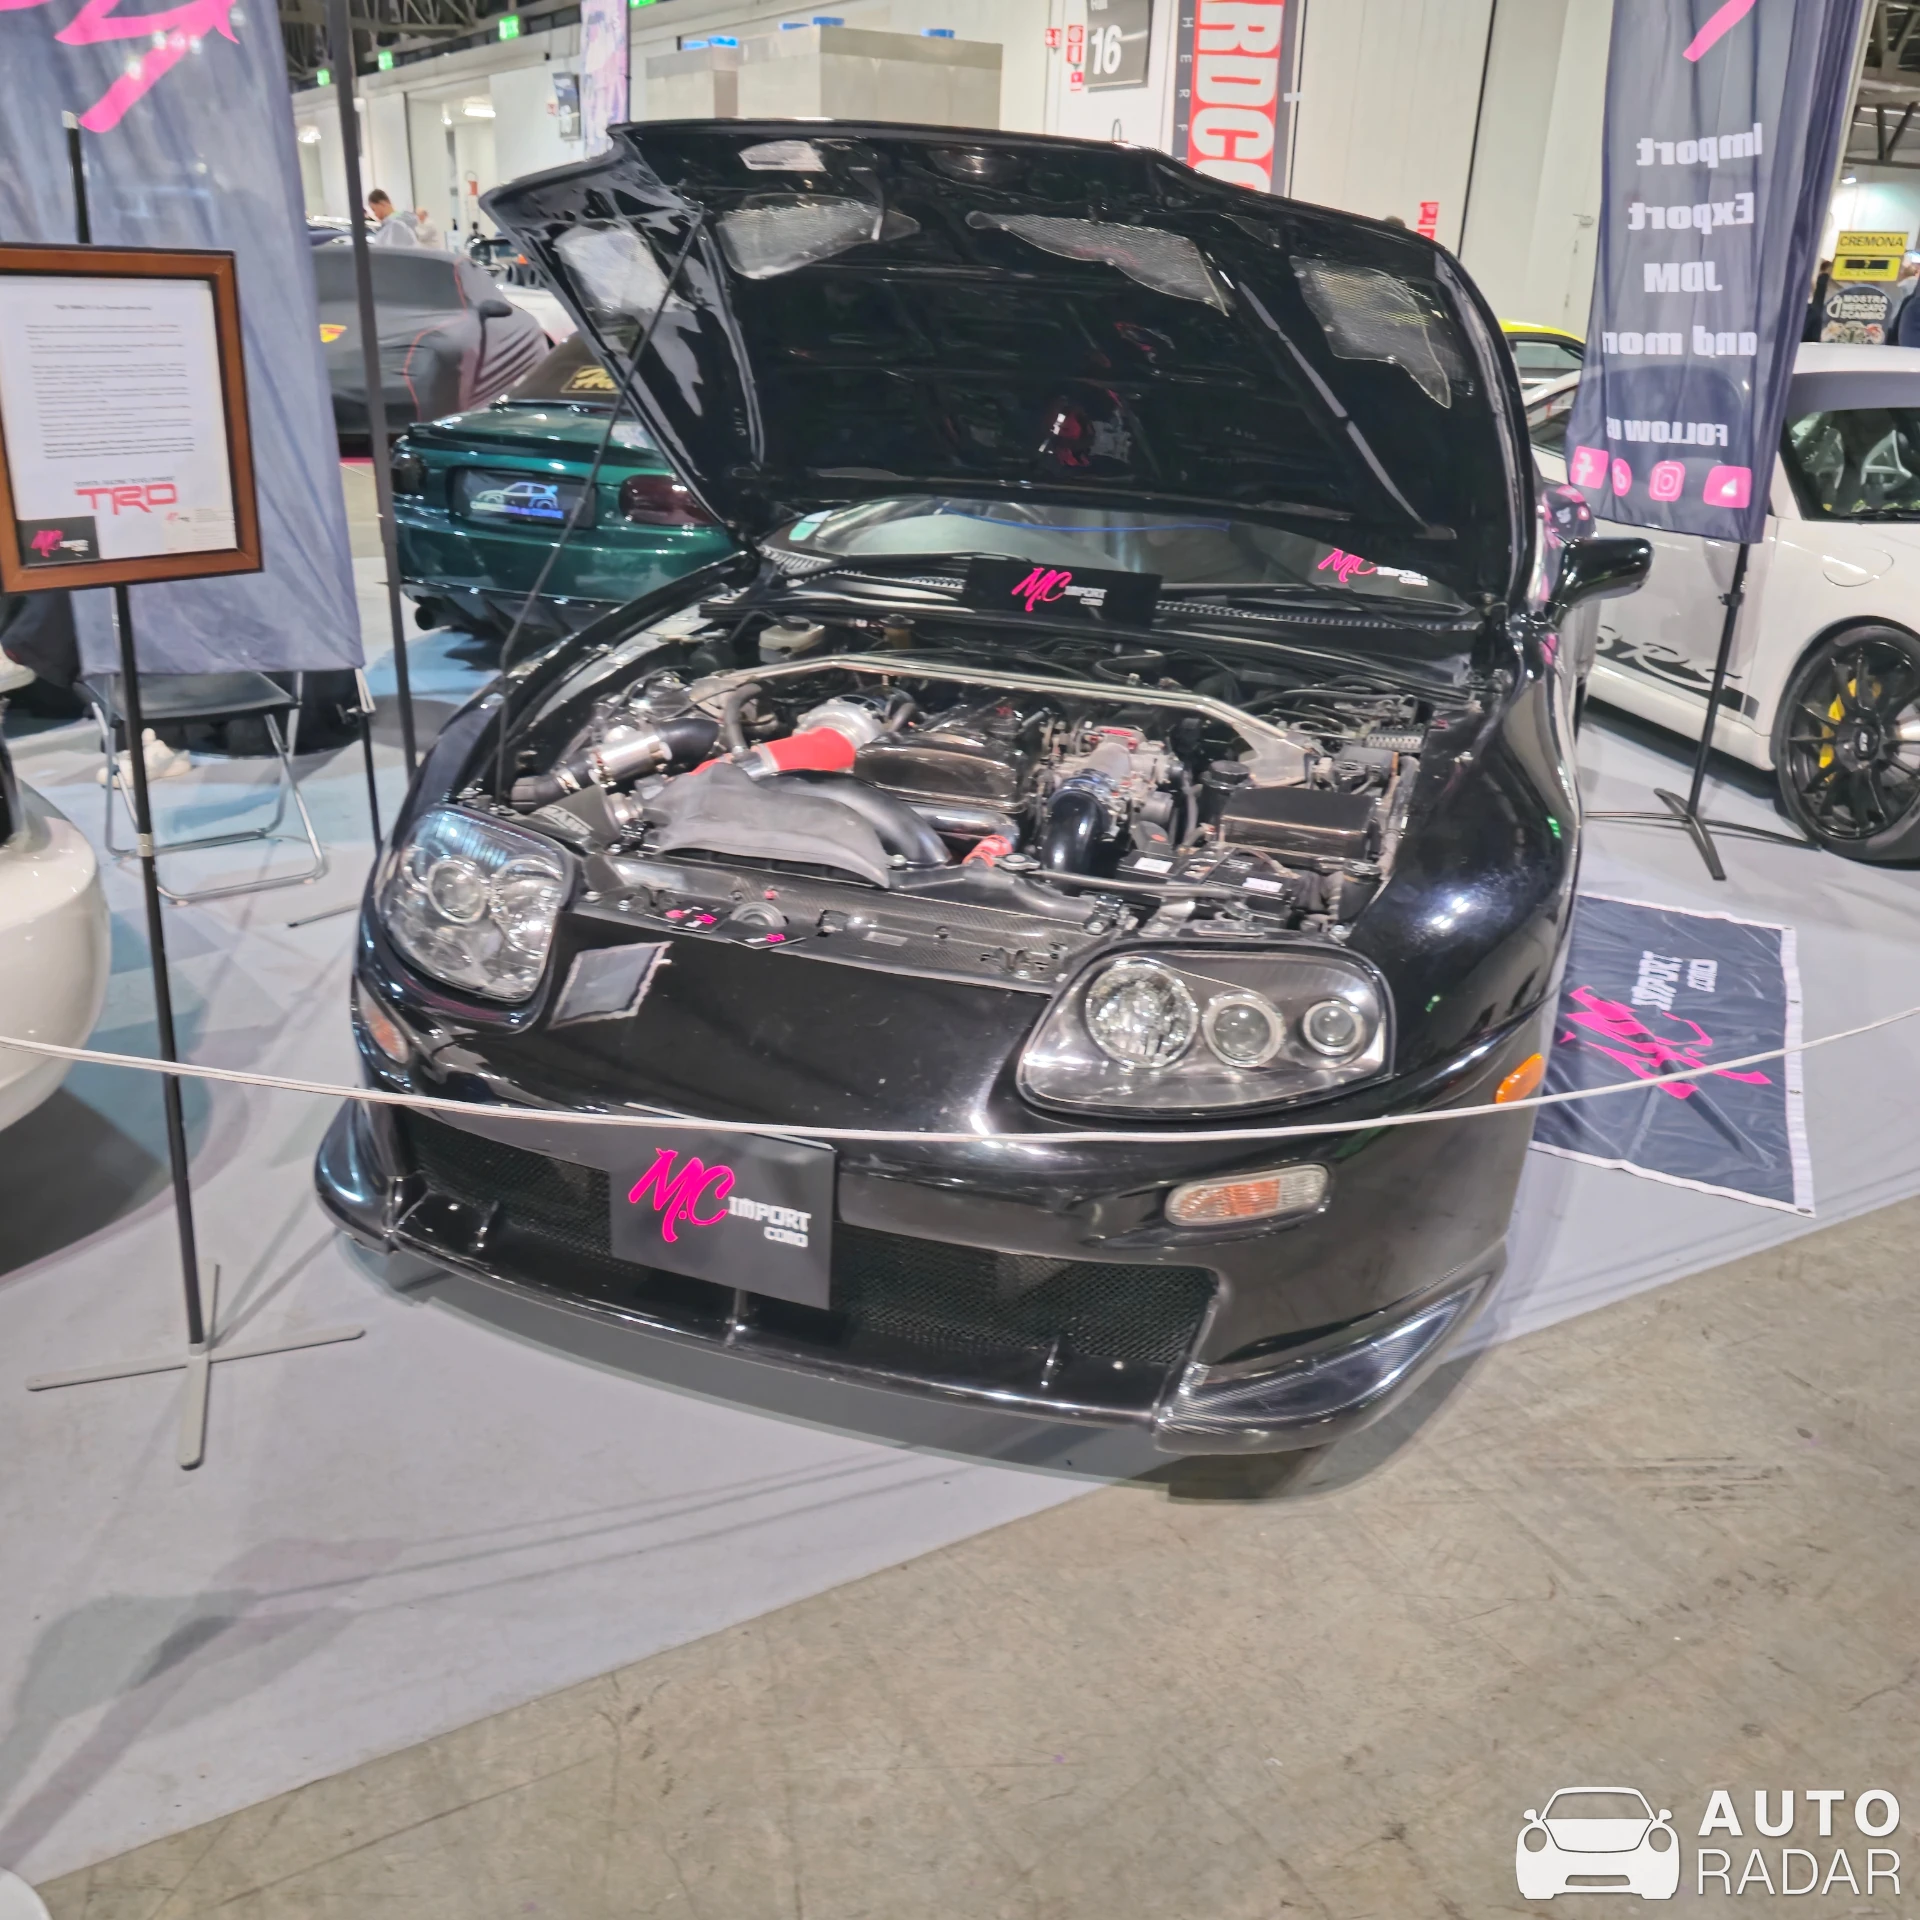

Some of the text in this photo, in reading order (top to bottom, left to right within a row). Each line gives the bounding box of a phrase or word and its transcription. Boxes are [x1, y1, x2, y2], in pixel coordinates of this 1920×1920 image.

[1091, 25, 1122, 74] 16
[1839, 235, 1904, 247] CREMONA
[74, 483, 179, 515] TRD
[727, 1195, 812, 1232] IMPORT
